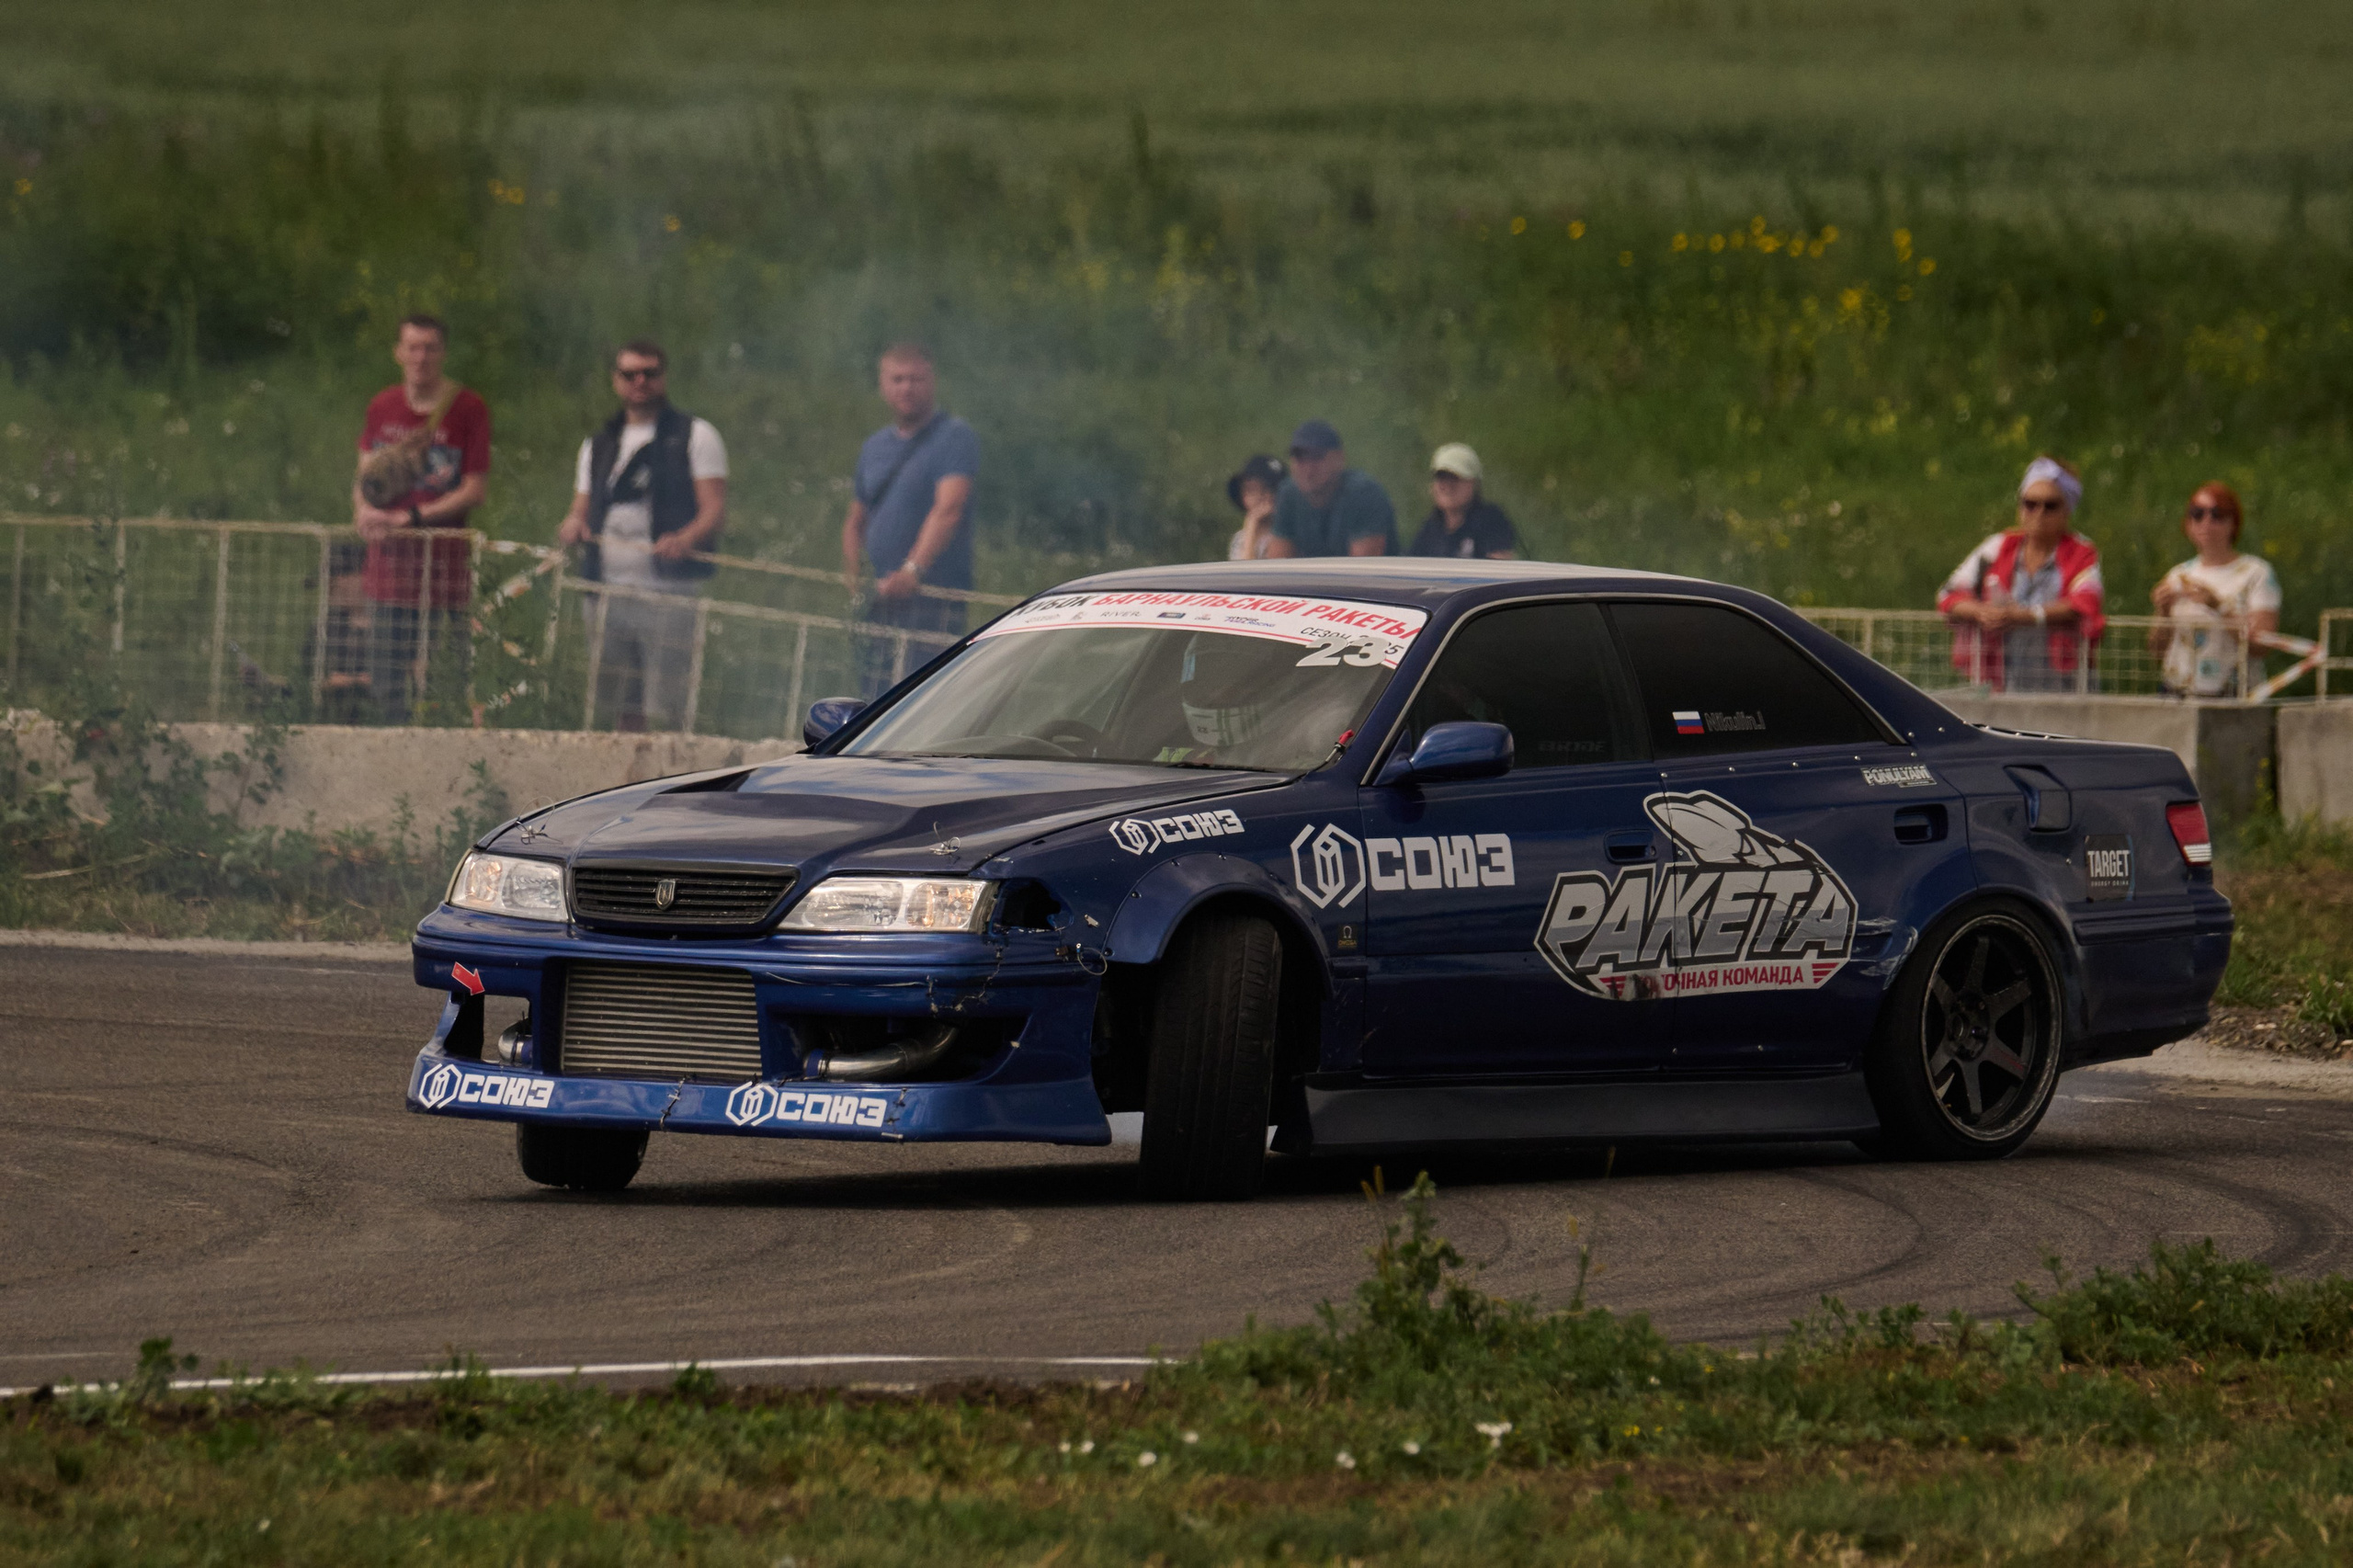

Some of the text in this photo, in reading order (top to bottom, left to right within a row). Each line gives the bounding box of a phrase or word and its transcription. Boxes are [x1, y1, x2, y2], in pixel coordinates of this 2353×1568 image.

[1091, 593, 1305, 615] БАРНАУЛЬСКОЙ
[1305, 604, 1422, 640] РАКЕТЫ
[1295, 636, 1387, 667] 23
[1151, 809, 1245, 844] СОЮЗ
[1365, 833, 1516, 891] СОЮЗ
[2087, 850, 2131, 878] TARGET
[1722, 965, 1804, 986] КОМАНДА
[459, 1075, 555, 1109] СОЮЗ
[776, 1091, 888, 1129] СОЮЗ
